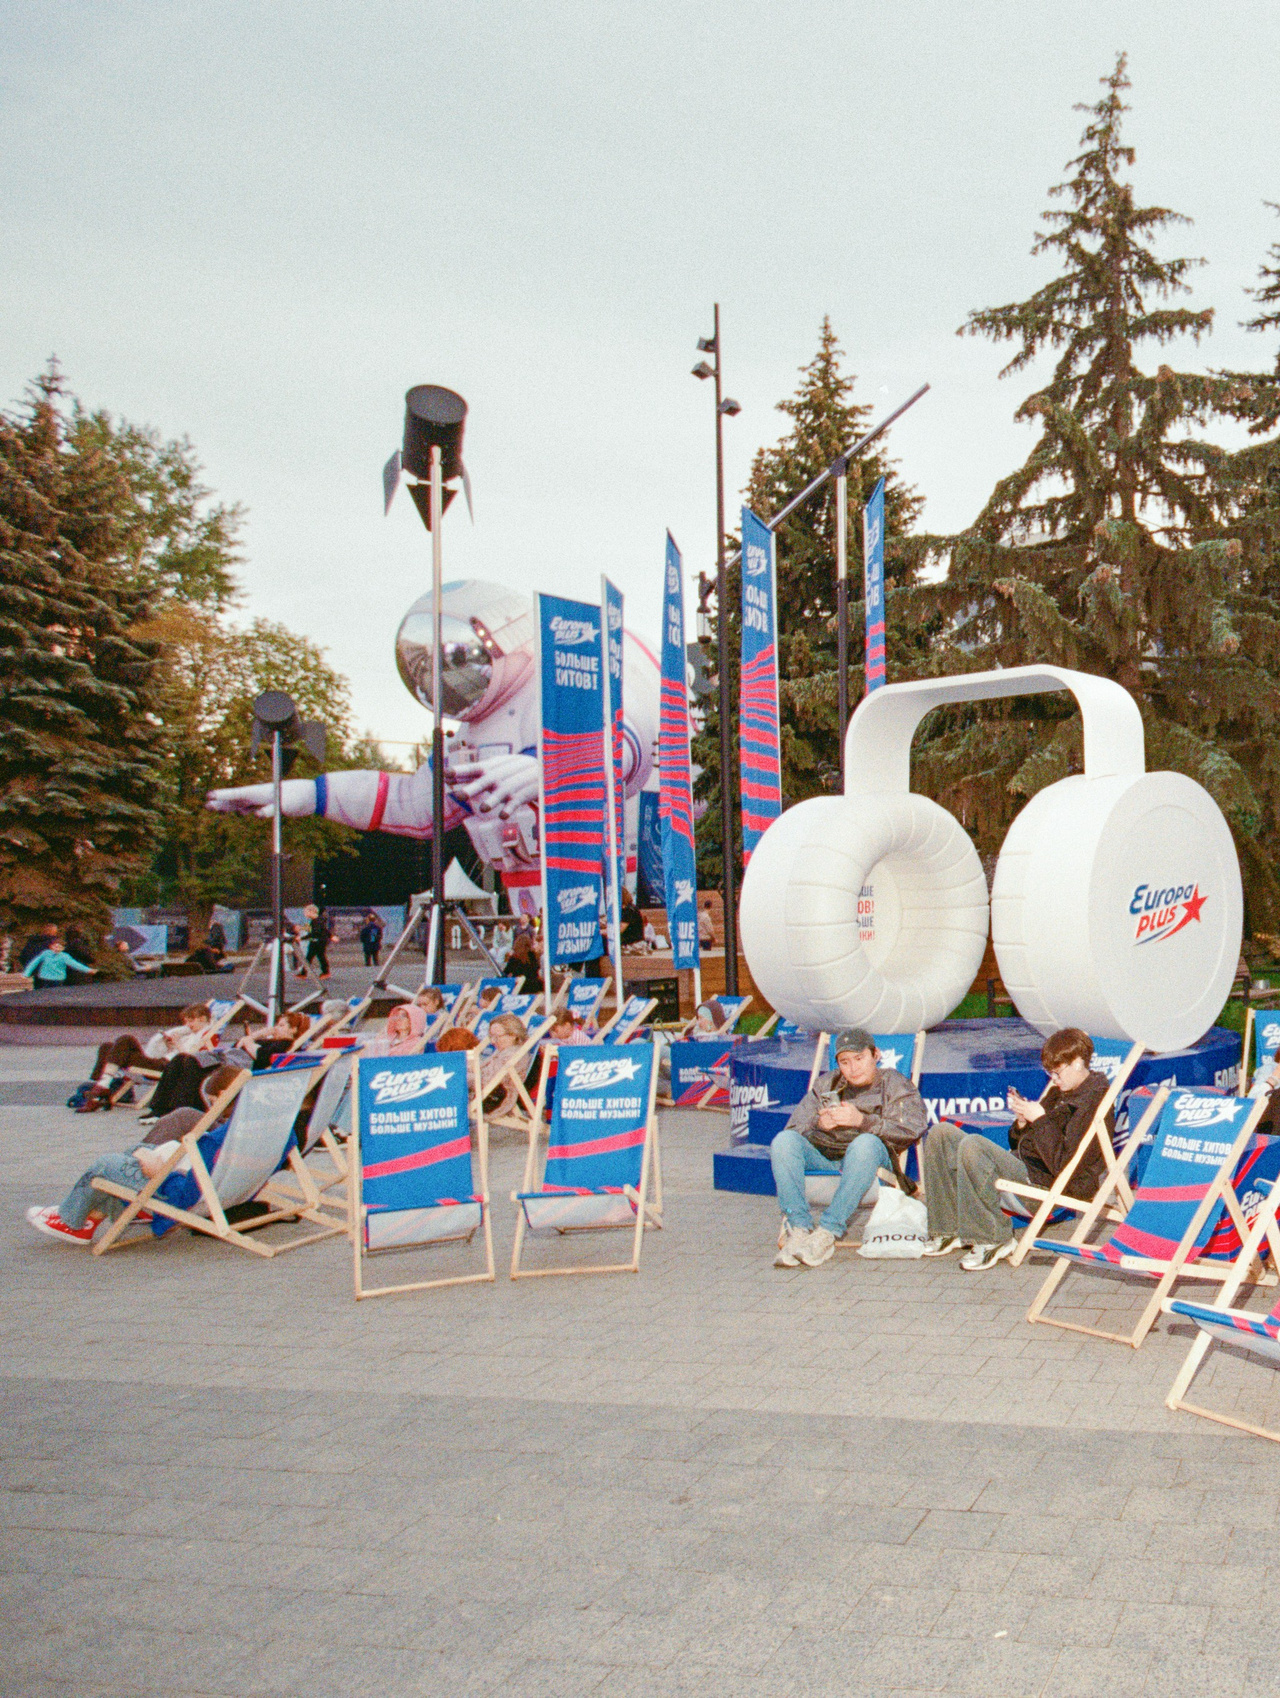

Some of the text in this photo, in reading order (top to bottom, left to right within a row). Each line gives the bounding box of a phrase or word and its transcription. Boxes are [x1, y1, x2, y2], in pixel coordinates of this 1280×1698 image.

[1128, 882, 1195, 915] Europa
[566, 1058, 630, 1076] Europa
[370, 1066, 443, 1089] Europa
[562, 1097, 641, 1110] БОЛЬШЕ ХИТОВ!
[1174, 1094, 1234, 1110] Europa
[370, 1106, 457, 1124] БОЛЬШЕ ХИТОВ!
[561, 1109, 598, 1120] БОЛЬШЕ
[370, 1119, 457, 1135] БОЛЬШЕ МУЗЫКИ!
[1165, 1134, 1202, 1152] БОЛЬШЕ
[1161, 1147, 1194, 1162] БОЛЬШЕ
